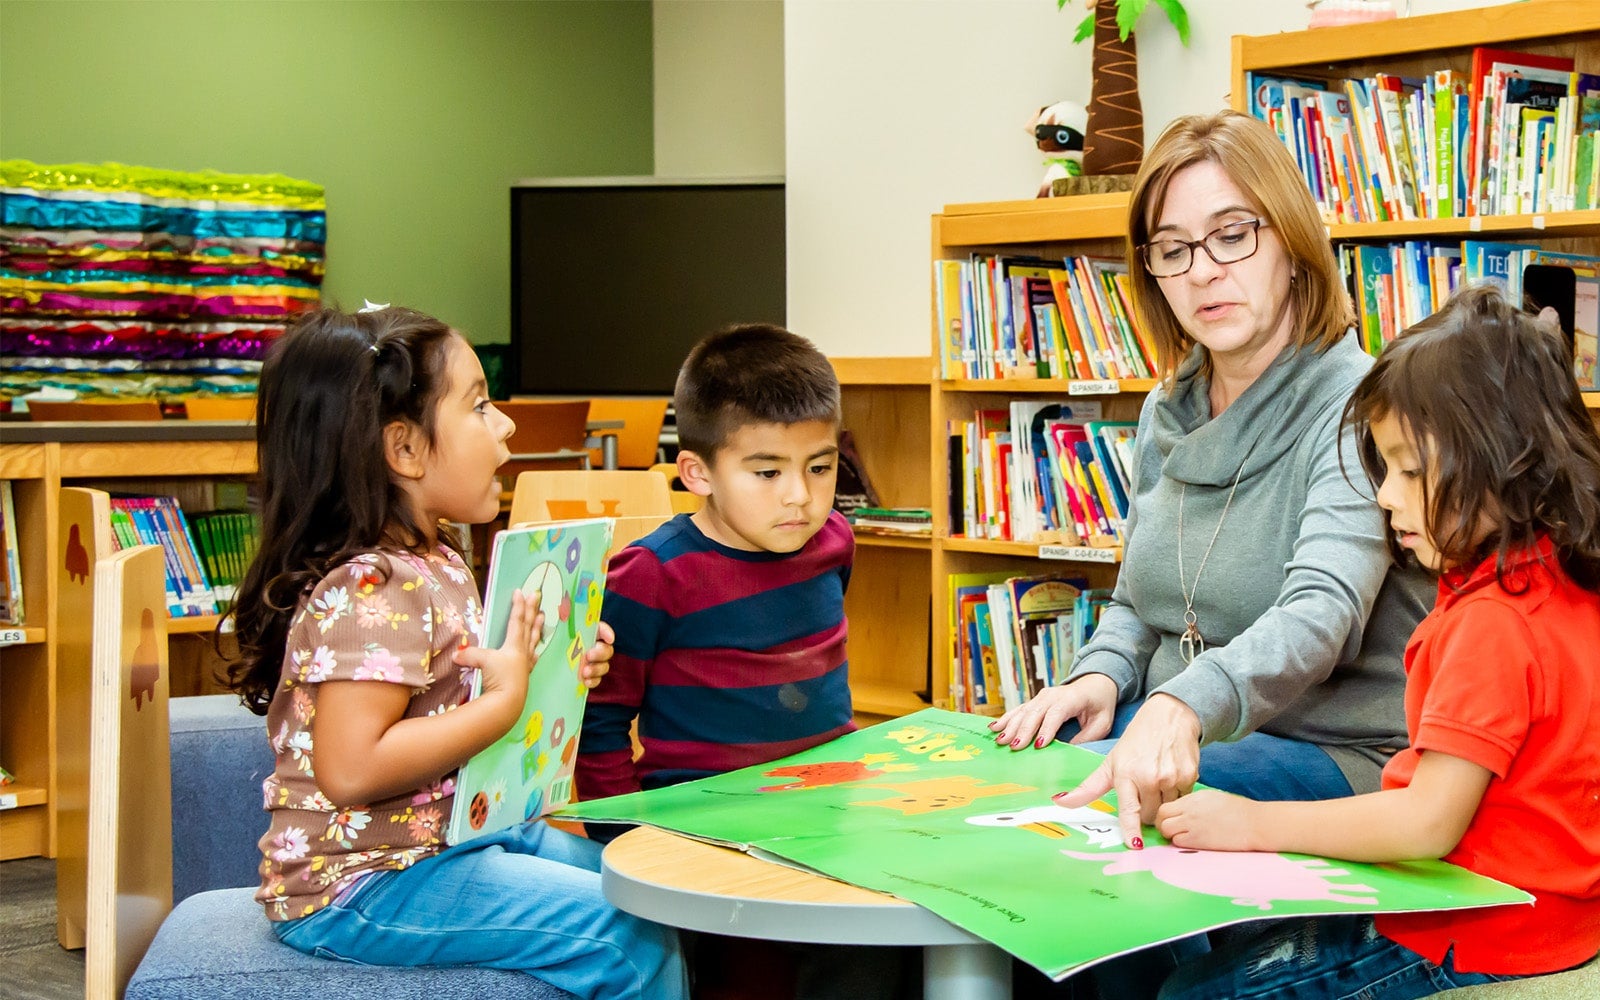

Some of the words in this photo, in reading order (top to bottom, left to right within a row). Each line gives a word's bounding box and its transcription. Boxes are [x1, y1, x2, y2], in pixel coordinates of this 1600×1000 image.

[1071, 384, 1103, 392] SPANISH
[1042, 547, 1070, 556] SPANISH
[969, 896, 998, 909] there
[997, 908, 1026, 923] Once
